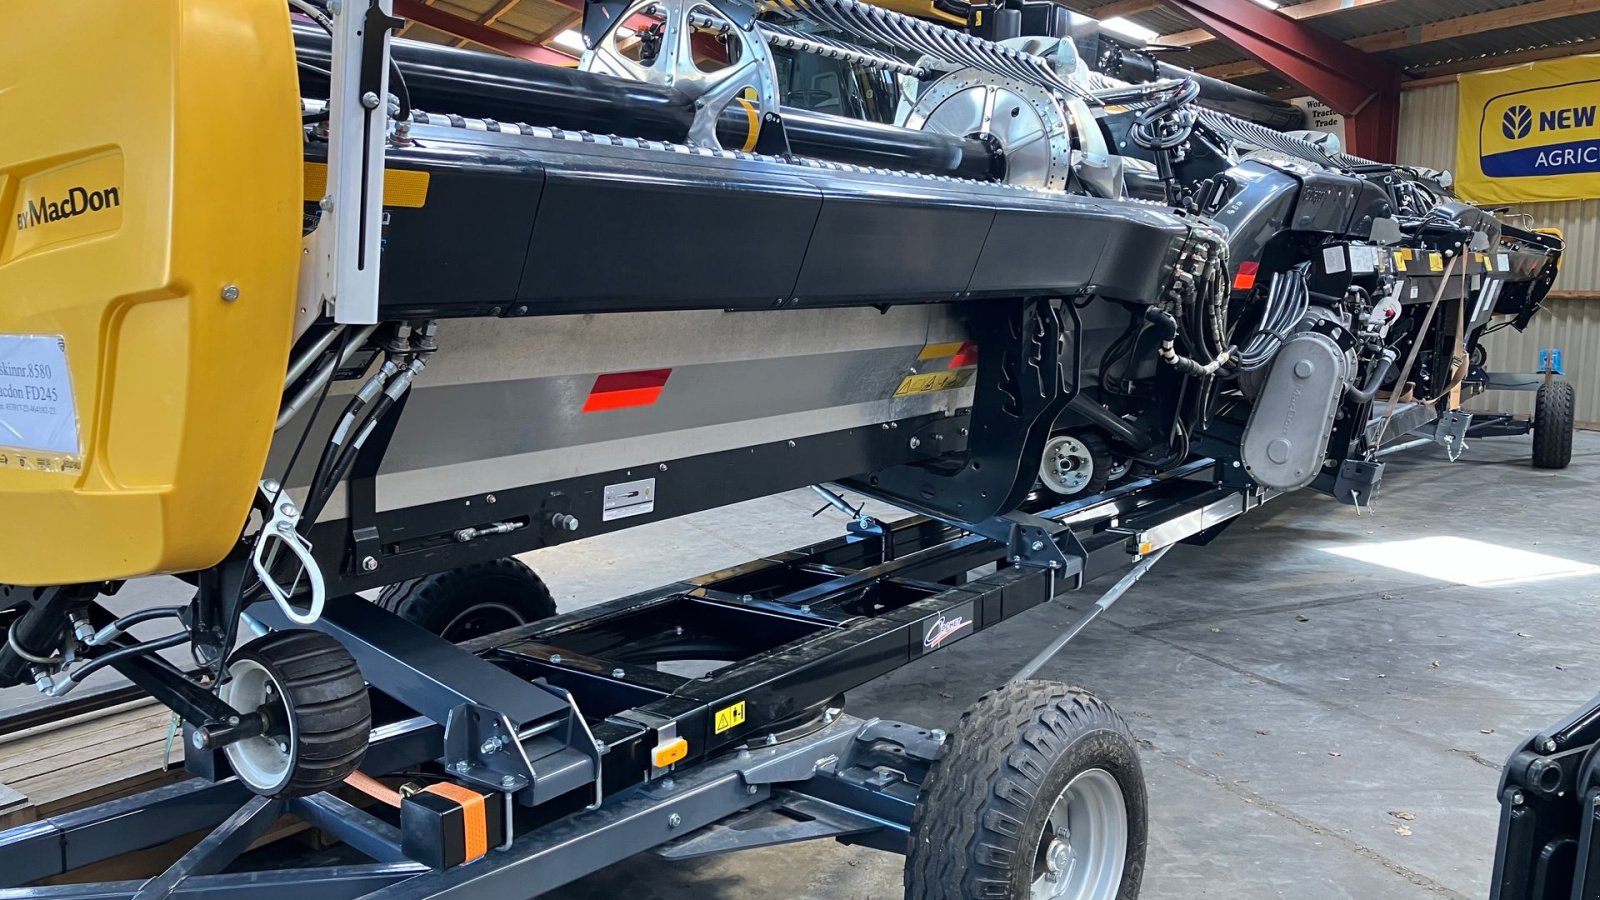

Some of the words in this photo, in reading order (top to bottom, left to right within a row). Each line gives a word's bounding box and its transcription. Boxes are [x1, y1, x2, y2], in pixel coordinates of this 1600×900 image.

[1312, 109, 1337, 118] Tracto
[1315, 118, 1338, 127] Trade
[1539, 105, 1597, 132] NEW
[1535, 146, 1600, 168] AGRIC
[28, 186, 120, 227] MacDon
[0, 361, 52, 379] skinnr.8580
[25, 385, 58, 402] FD245
